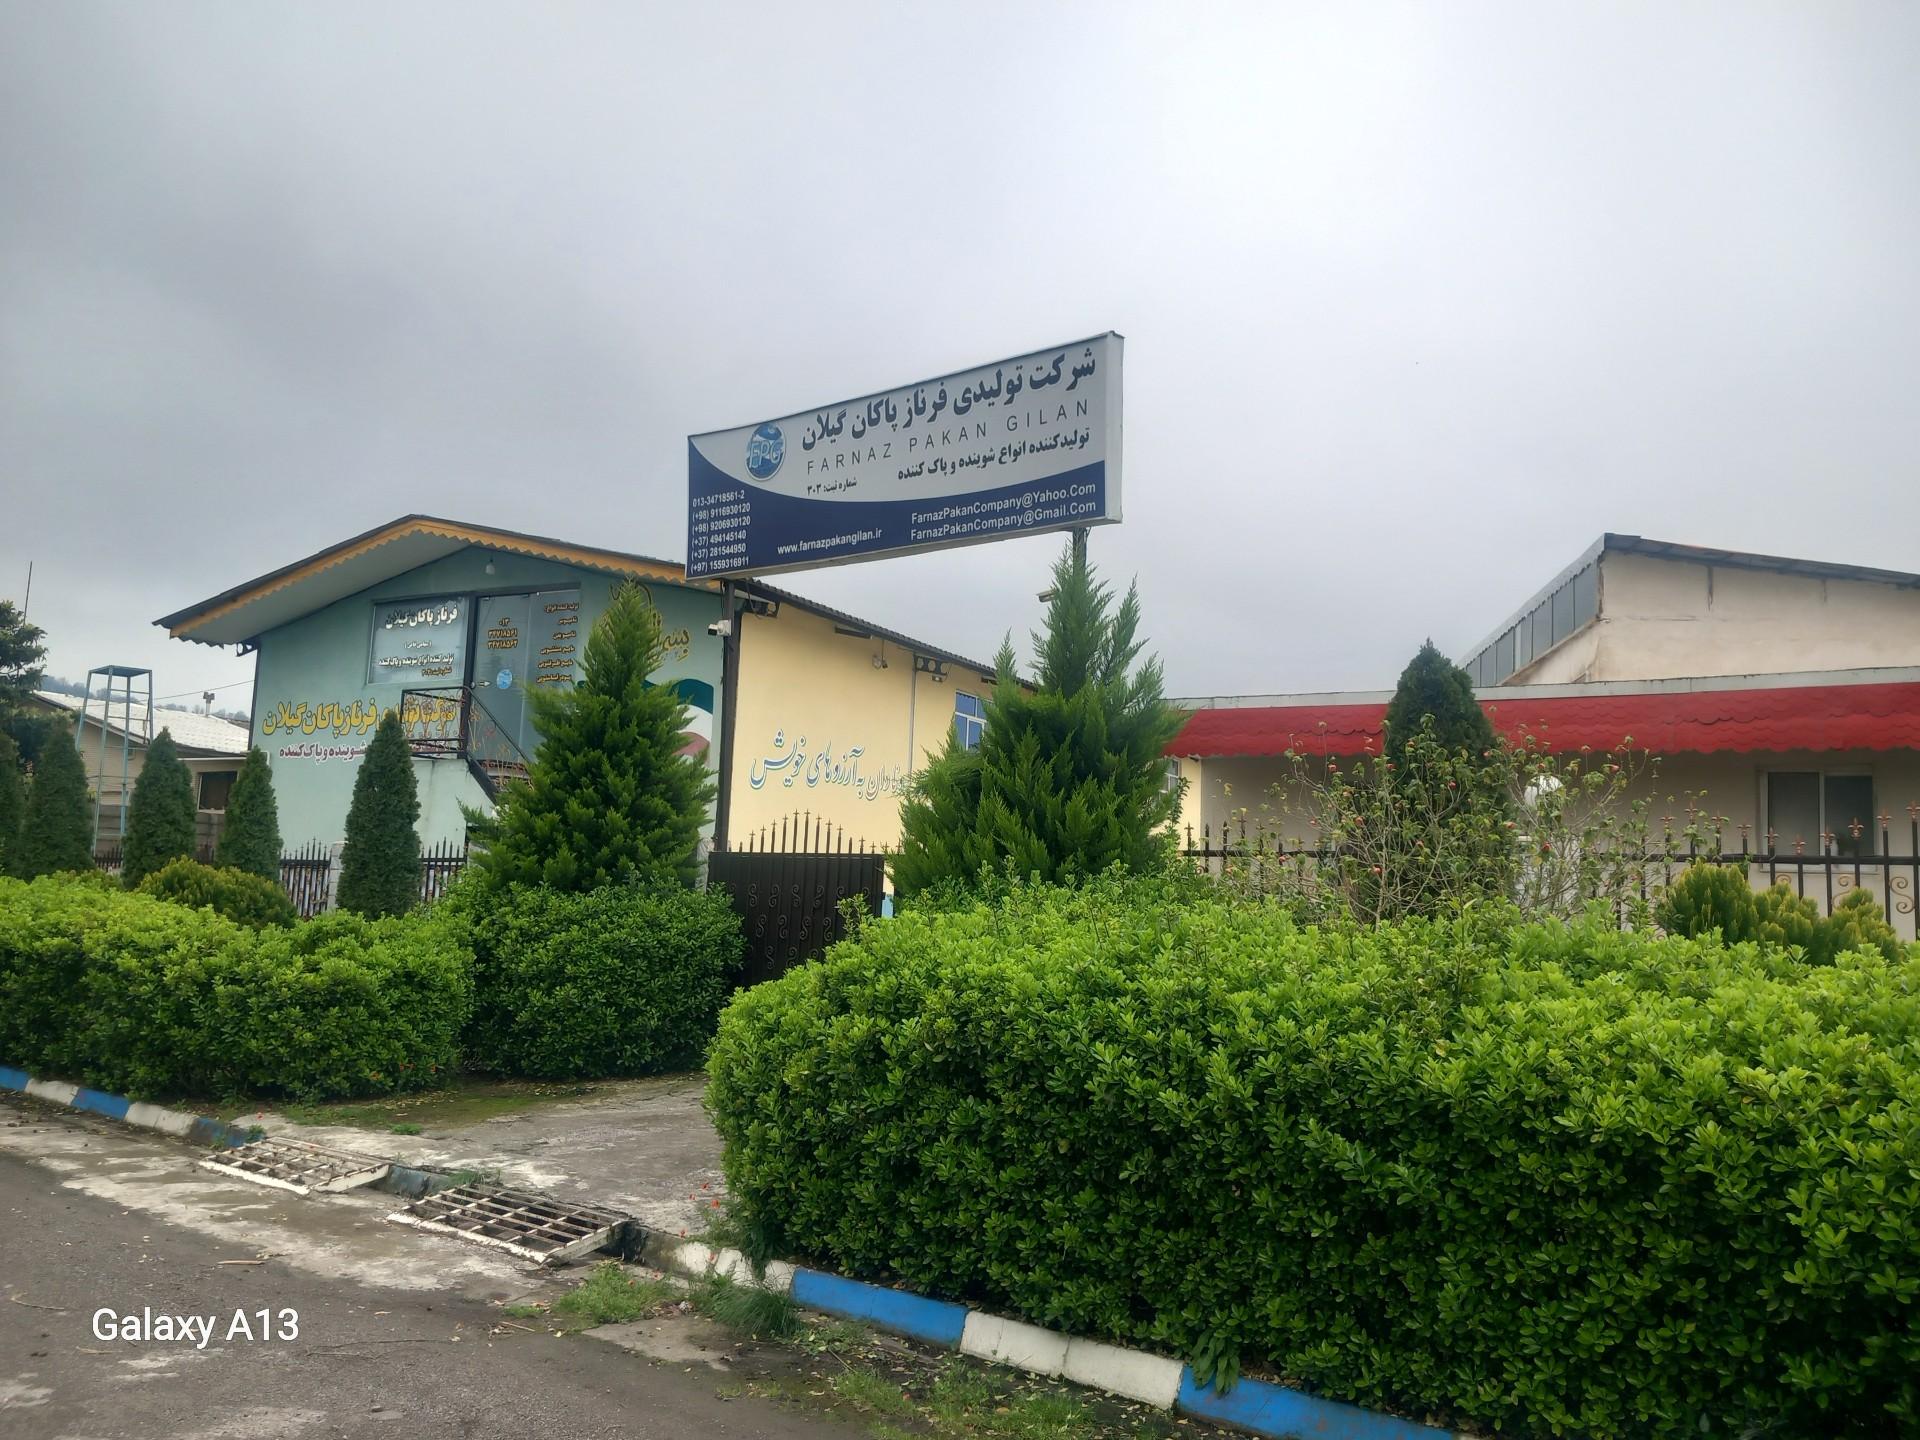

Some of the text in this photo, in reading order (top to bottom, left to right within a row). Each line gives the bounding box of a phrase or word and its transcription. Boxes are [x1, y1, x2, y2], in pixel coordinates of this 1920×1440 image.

[802, 347, 1095, 451] شرکت تولیدی فرناز پاکان گیلان
[807, 399, 1088, 475] FARNAZ PAKAN GILAN
[959, 448, 995, 469] شوینده
[998, 440, 1026, 465] انواع
[898, 461, 925, 480] کننده
[927, 458, 947, 477] پاک
[950, 460, 956, 475] و
[838, 476, 858, 492] شماره
[911, 482, 1096, 525] FarnazPakanCompany@Yahoo.Com
[692, 510, 709, 522] (+98)
[910, 500, 1096, 541] FarnazPakanCompany@Gmail.Com
[692, 523, 709, 535] (+98)
[691, 536, 708, 548] (+37)
[777, 527, 883, 555] www.farnazpakangilan.ir
[691, 549, 708, 561] (+37)
[690, 562, 708, 574] (+97)
[409, 608, 434, 627] پاکان
[434, 604, 458, 626] فرناز
[262, 700, 308, 736] گیلان
[301, 701, 344, 739] پاکان
[340, 697, 378, 736] فرناز
[279, 742, 304, 758] کننده
[304, 743, 323, 765] پاک
